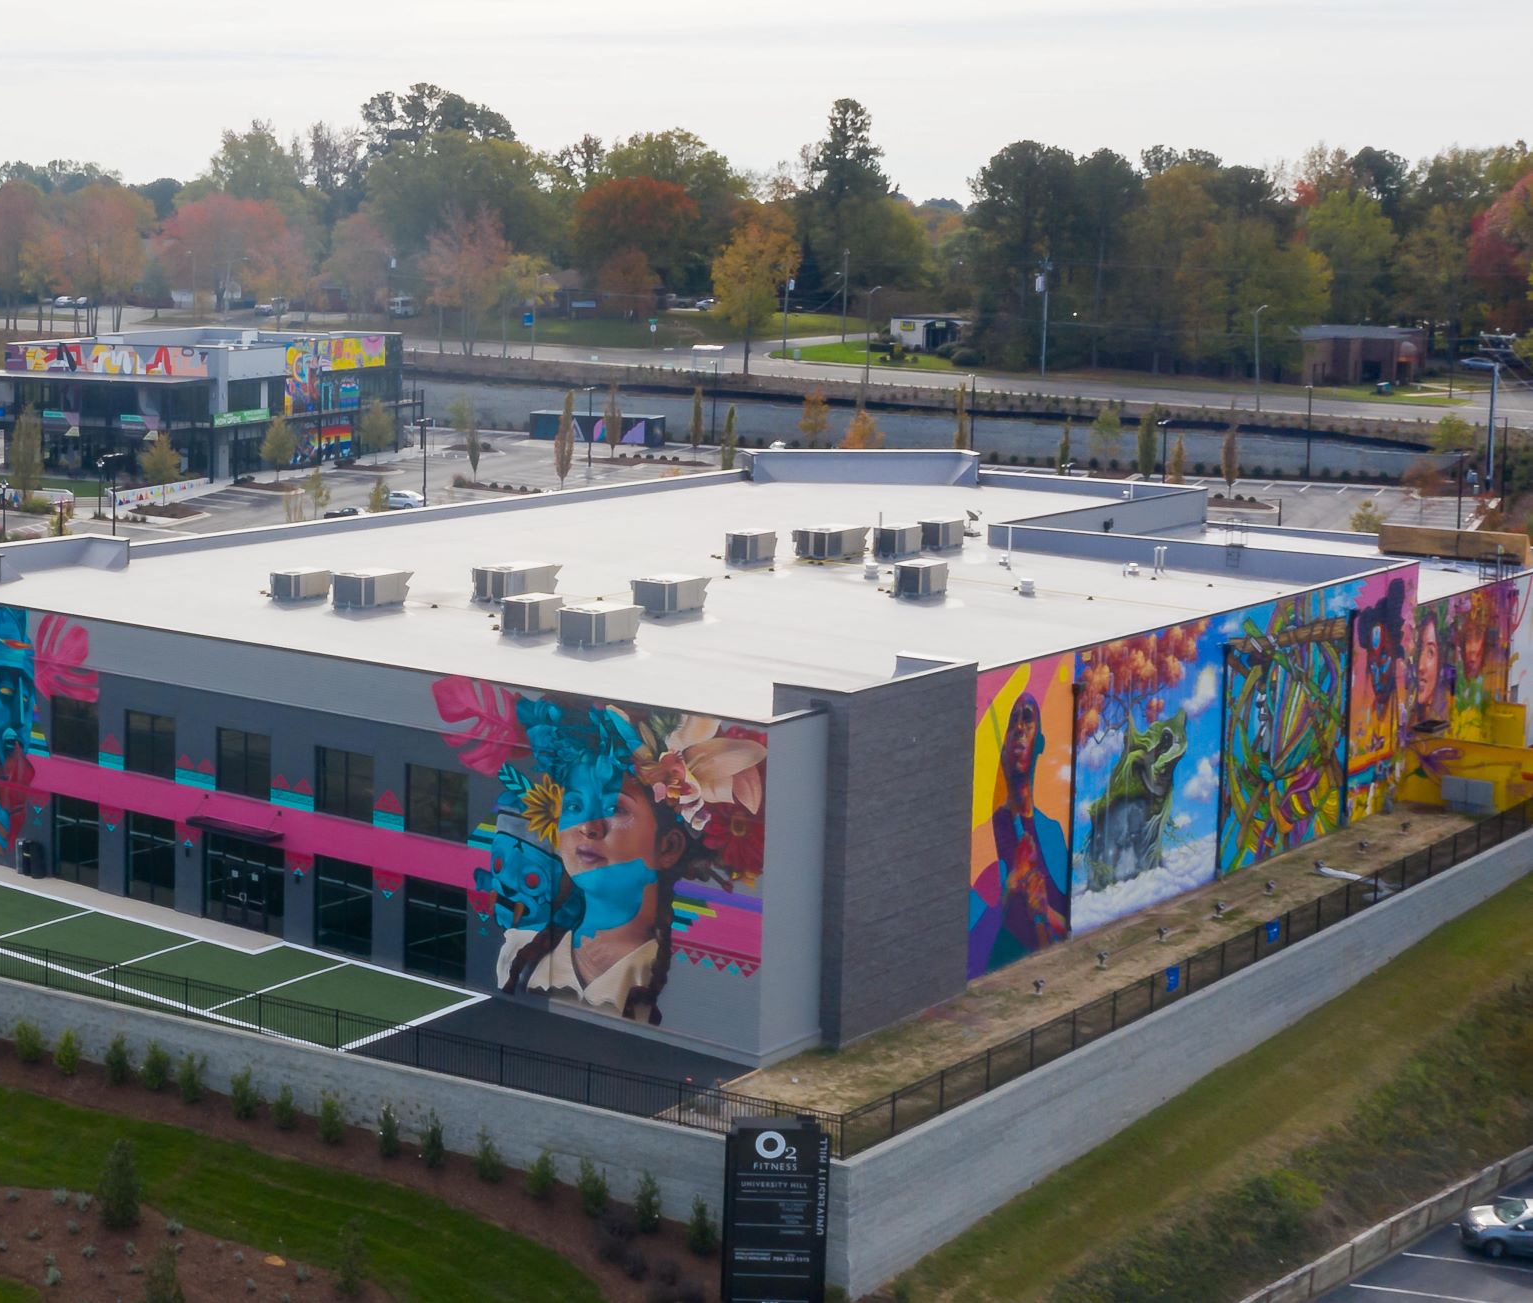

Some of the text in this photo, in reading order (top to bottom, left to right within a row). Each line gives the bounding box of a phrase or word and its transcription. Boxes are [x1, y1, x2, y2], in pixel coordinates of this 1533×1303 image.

[753, 1162, 798, 1171] FITNESS
[741, 1181, 808, 1190] UNIVERSITY HILL
[816, 1138, 828, 1235] UNIVERSITY HILL
